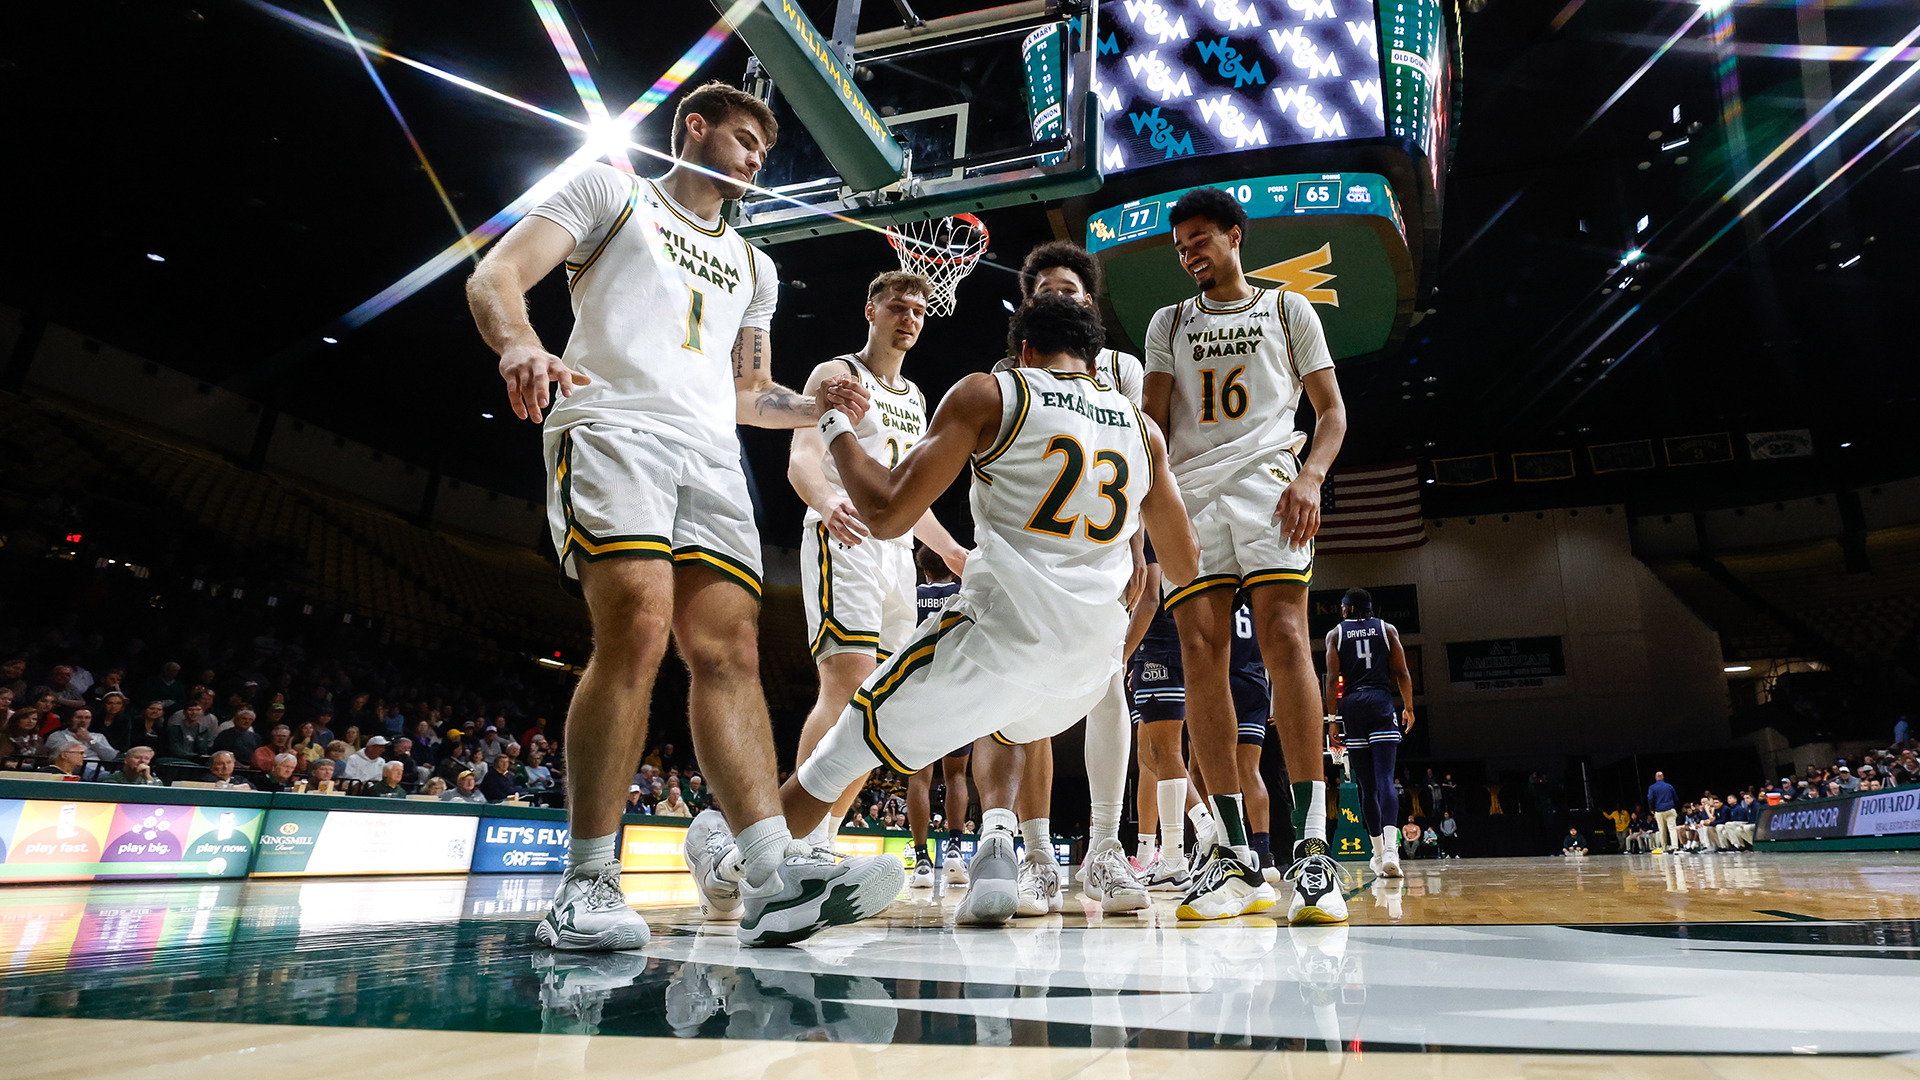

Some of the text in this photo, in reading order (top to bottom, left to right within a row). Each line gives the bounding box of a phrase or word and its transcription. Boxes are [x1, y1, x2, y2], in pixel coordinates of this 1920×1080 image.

[1395, 15, 1405, 24] 16
[1033, 24, 1052, 40] MARY
[1394, 26, 1422, 40] 22 2
[1393, 39, 1420, 53] 23 2
[1394, 53, 1408, 61] OLD
[783, 0, 842, 86] WILLIAM
[852, 93, 888, 143] MARY
[1396, 78, 1402, 87] 2
[1396, 92, 1418, 105] 3 2
[1396, 104, 1417, 117] 4 1
[1396, 116, 1417, 128] 6 2
[1394, 127, 1405, 136] 13
[1306, 186, 1330, 202] 65
[1130, 209, 1150, 227] 77
[652, 220, 741, 282] WILLIAM
[681, 283, 705, 355] 1
[1187, 325, 1264, 344] WILLIAM
[1199, 365, 1249, 423] 16
[874, 399, 921, 424] WILLIAM
[1042, 392, 1131, 428] EMANUEL
[1024, 434, 1130, 544] 23
[1234, 604, 1252, 639] 6
[1347, 628, 1378, 638] DAVIS JR.
[1356, 639, 1372, 669] 4
[1141, 668, 1168, 681] ODU
[1860, 794, 1914, 815] HOWARD
[1770, 807, 1839, 832] GAME SPONSOR
[259, 835, 313, 845] KINGSMILL
[486, 826, 569, 848] LET'S FLY,
[25, 842, 89, 855] play fast.
[118, 842, 170, 855] play big.
[196, 843, 248, 854] play now.
